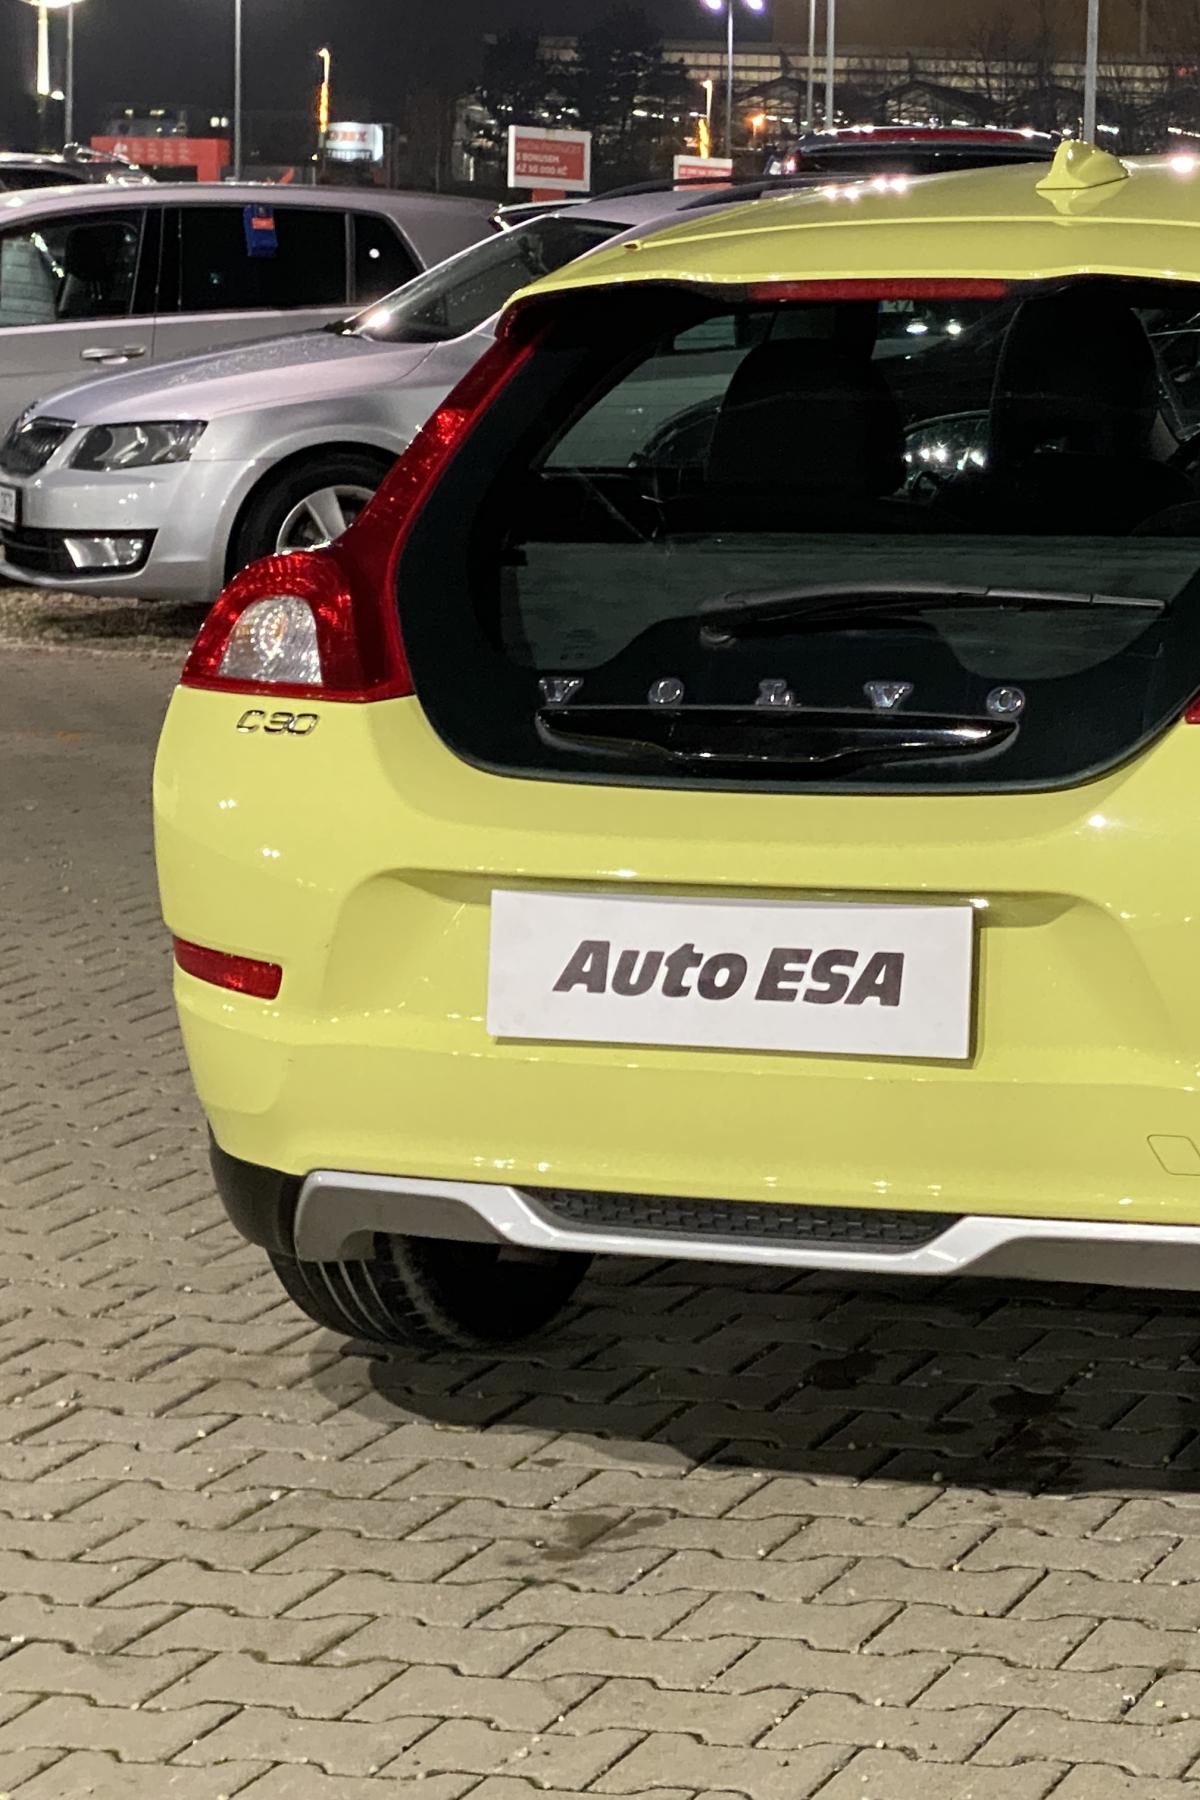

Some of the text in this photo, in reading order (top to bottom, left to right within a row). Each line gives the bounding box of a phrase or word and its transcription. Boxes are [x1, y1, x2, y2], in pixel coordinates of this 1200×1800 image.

[539, 676, 1026, 716] VOLVO
[236, 709, 319, 734] C30
[552, 939, 906, 1007] Auto ESA
